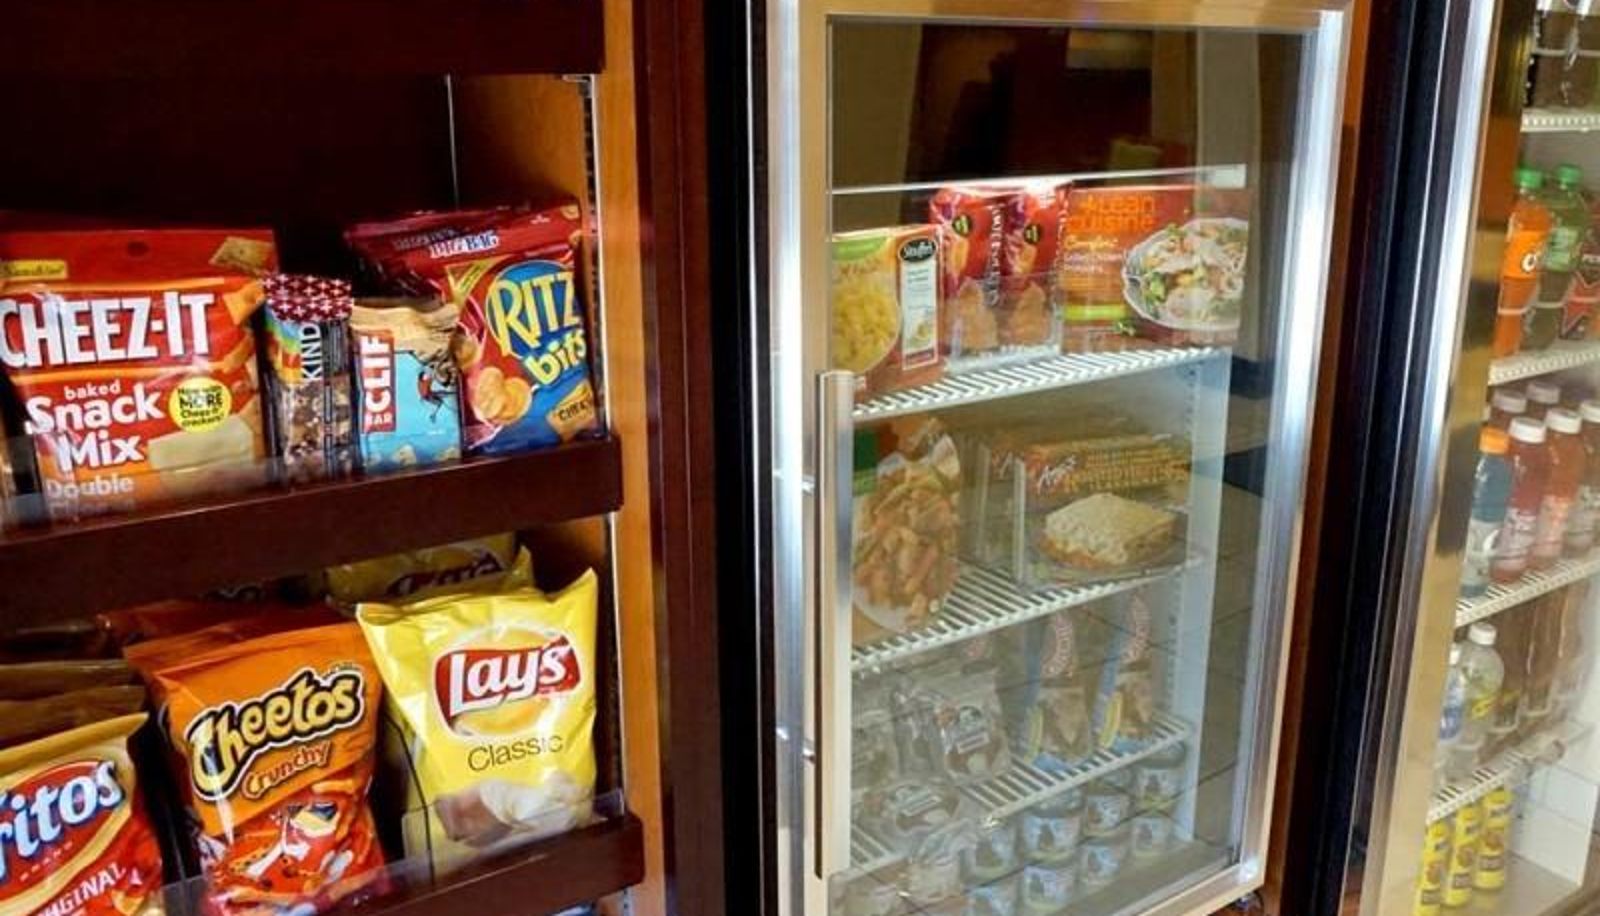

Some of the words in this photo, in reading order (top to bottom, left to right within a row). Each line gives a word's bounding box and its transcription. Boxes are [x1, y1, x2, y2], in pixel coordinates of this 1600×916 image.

[0, 291, 215, 368] CHEEZ-IT
[489, 271, 582, 358] RITZ
[299, 322, 323, 381] KIND
[360, 335, 392, 413] CLIF
[524, 328, 588, 385] bits
[24, 384, 167, 436] Snack
[63, 379, 121, 401] baked
[178, 392, 223, 409] MORE
[362, 410, 394, 426] BAR
[55, 430, 145, 474] Mix
[44, 472, 135, 499] Double
[188, 675, 358, 795] Cheetos
[467, 735, 564, 773] Classic
[244, 741, 330, 798] Crunchy
[0, 761, 123, 880] ritos
